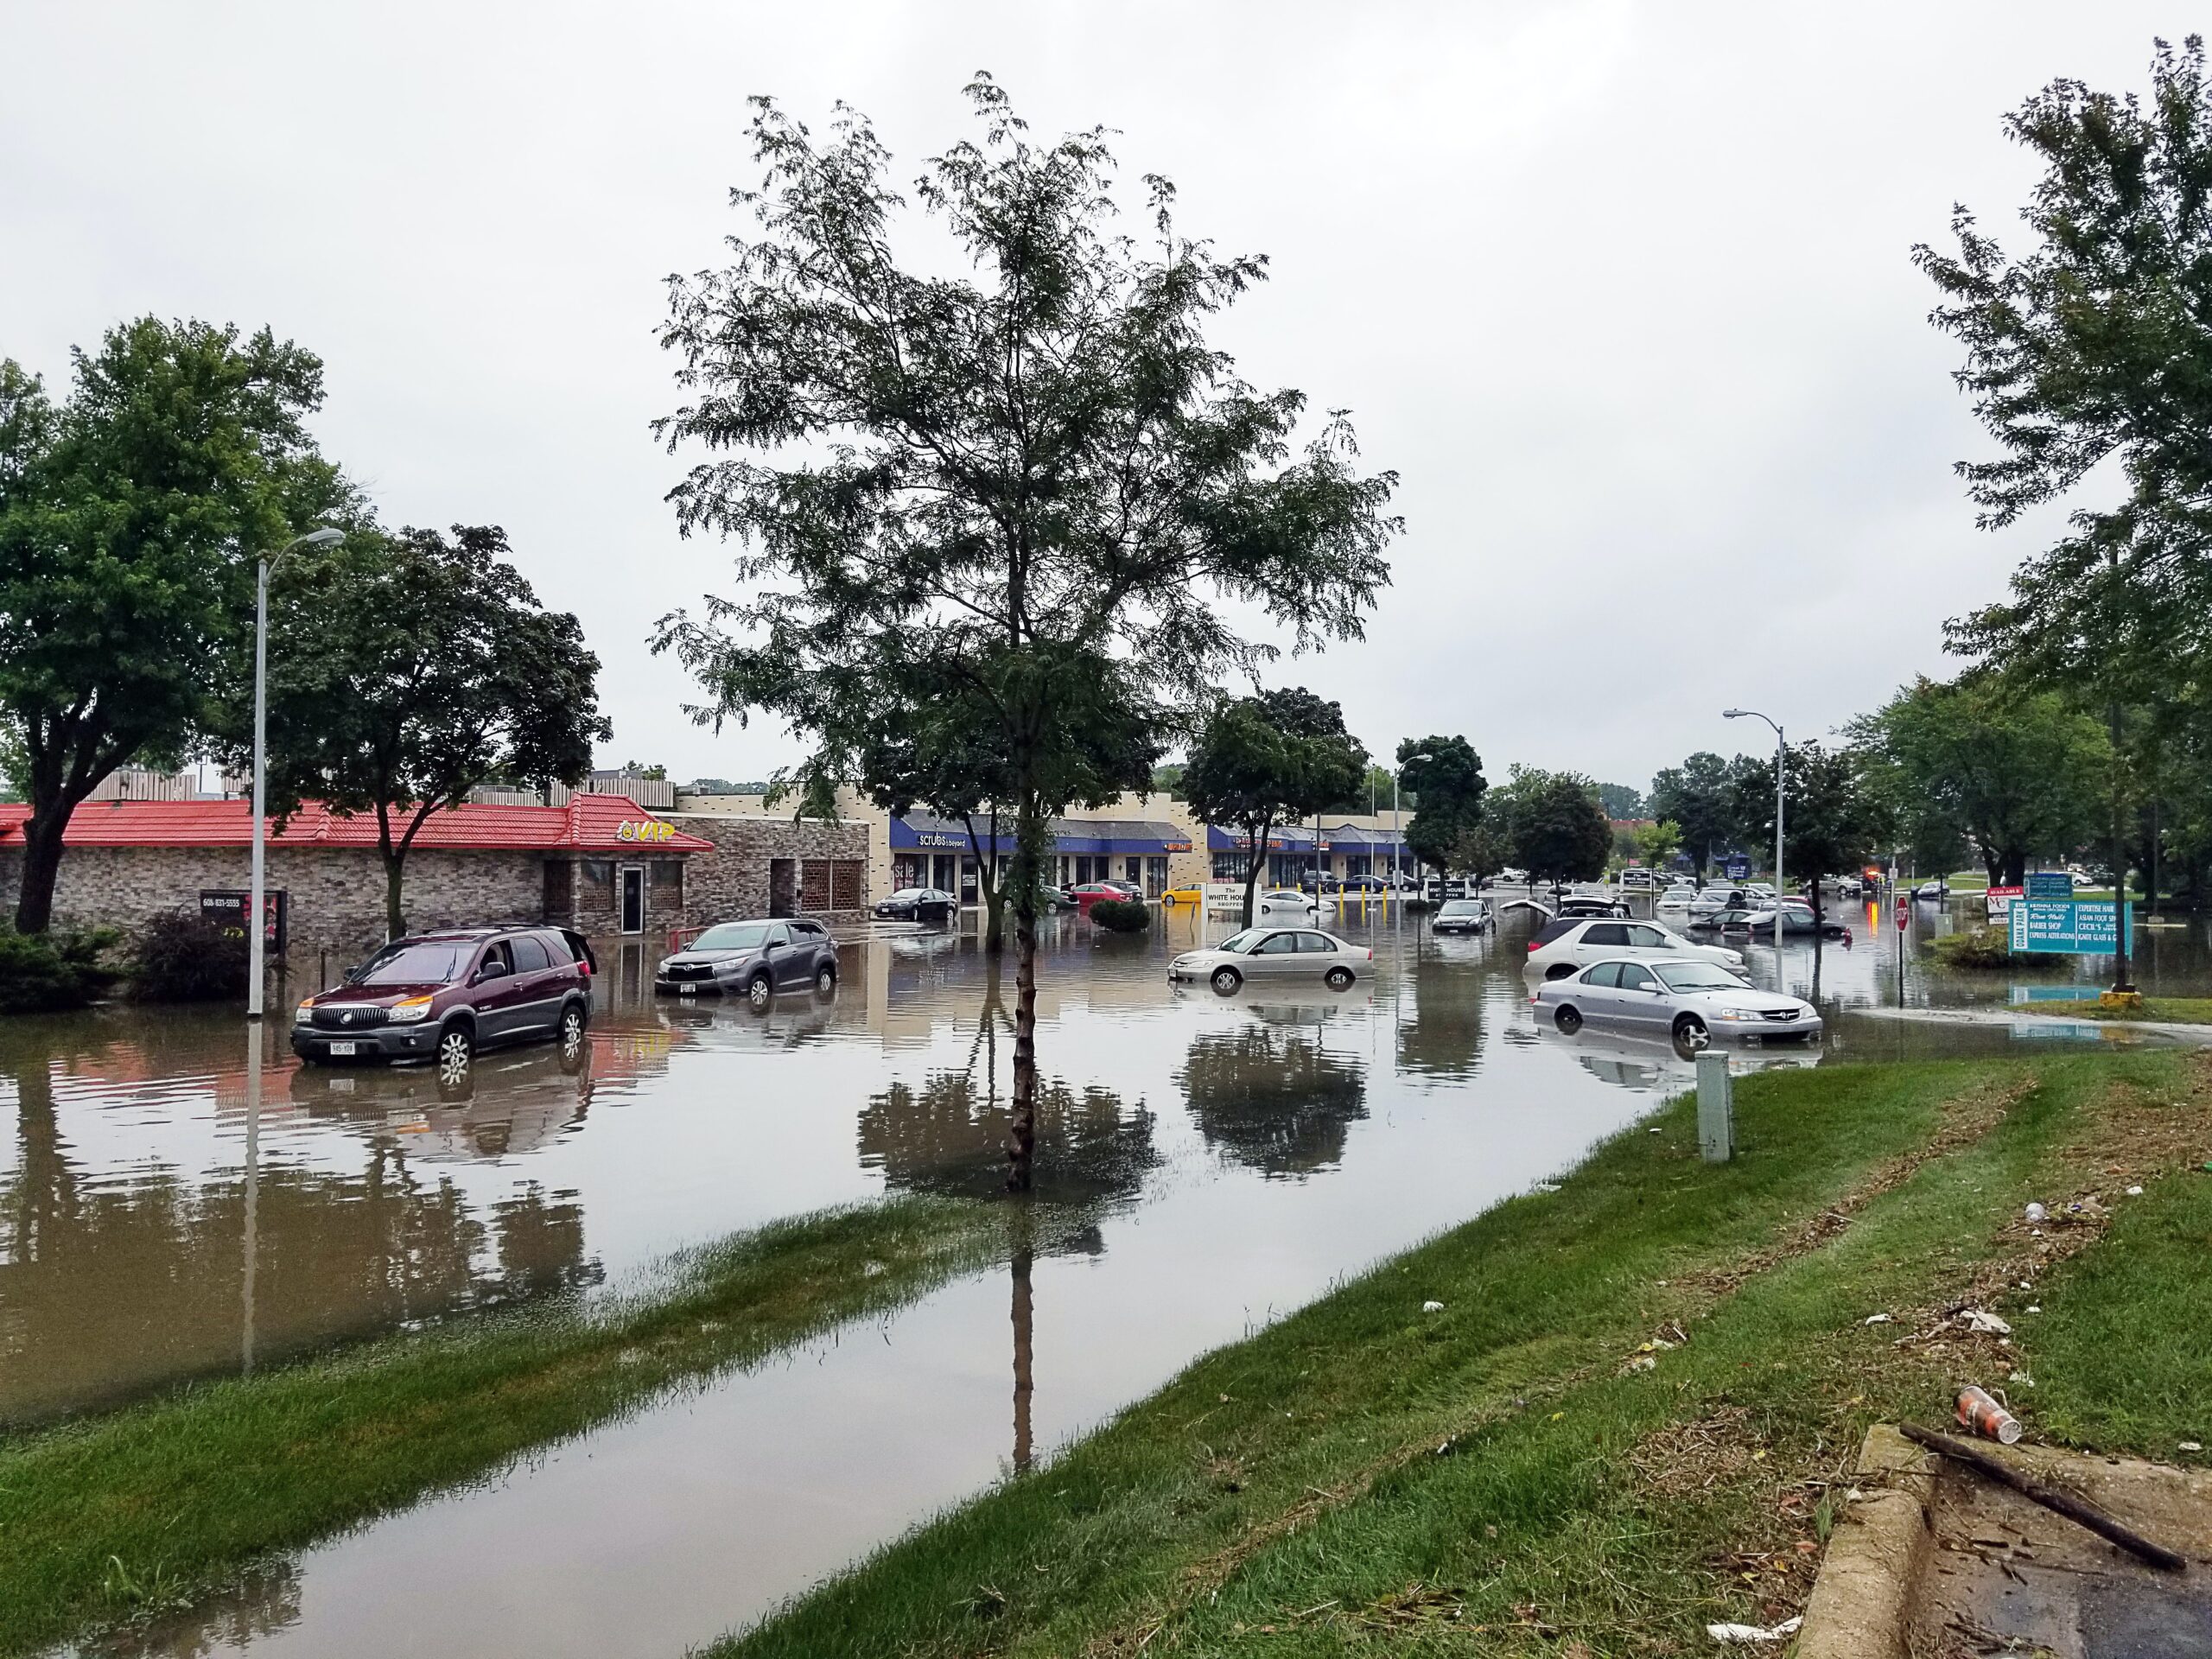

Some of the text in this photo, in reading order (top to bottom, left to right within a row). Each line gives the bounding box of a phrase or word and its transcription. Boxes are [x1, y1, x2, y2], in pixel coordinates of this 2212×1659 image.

[634, 821, 675, 842] VIP
[919, 832, 946, 846] scrubs
[949, 840, 966, 849] beyond
[1896, 907, 1908, 921] STOP
[2016, 911, 2024, 925] PARK
